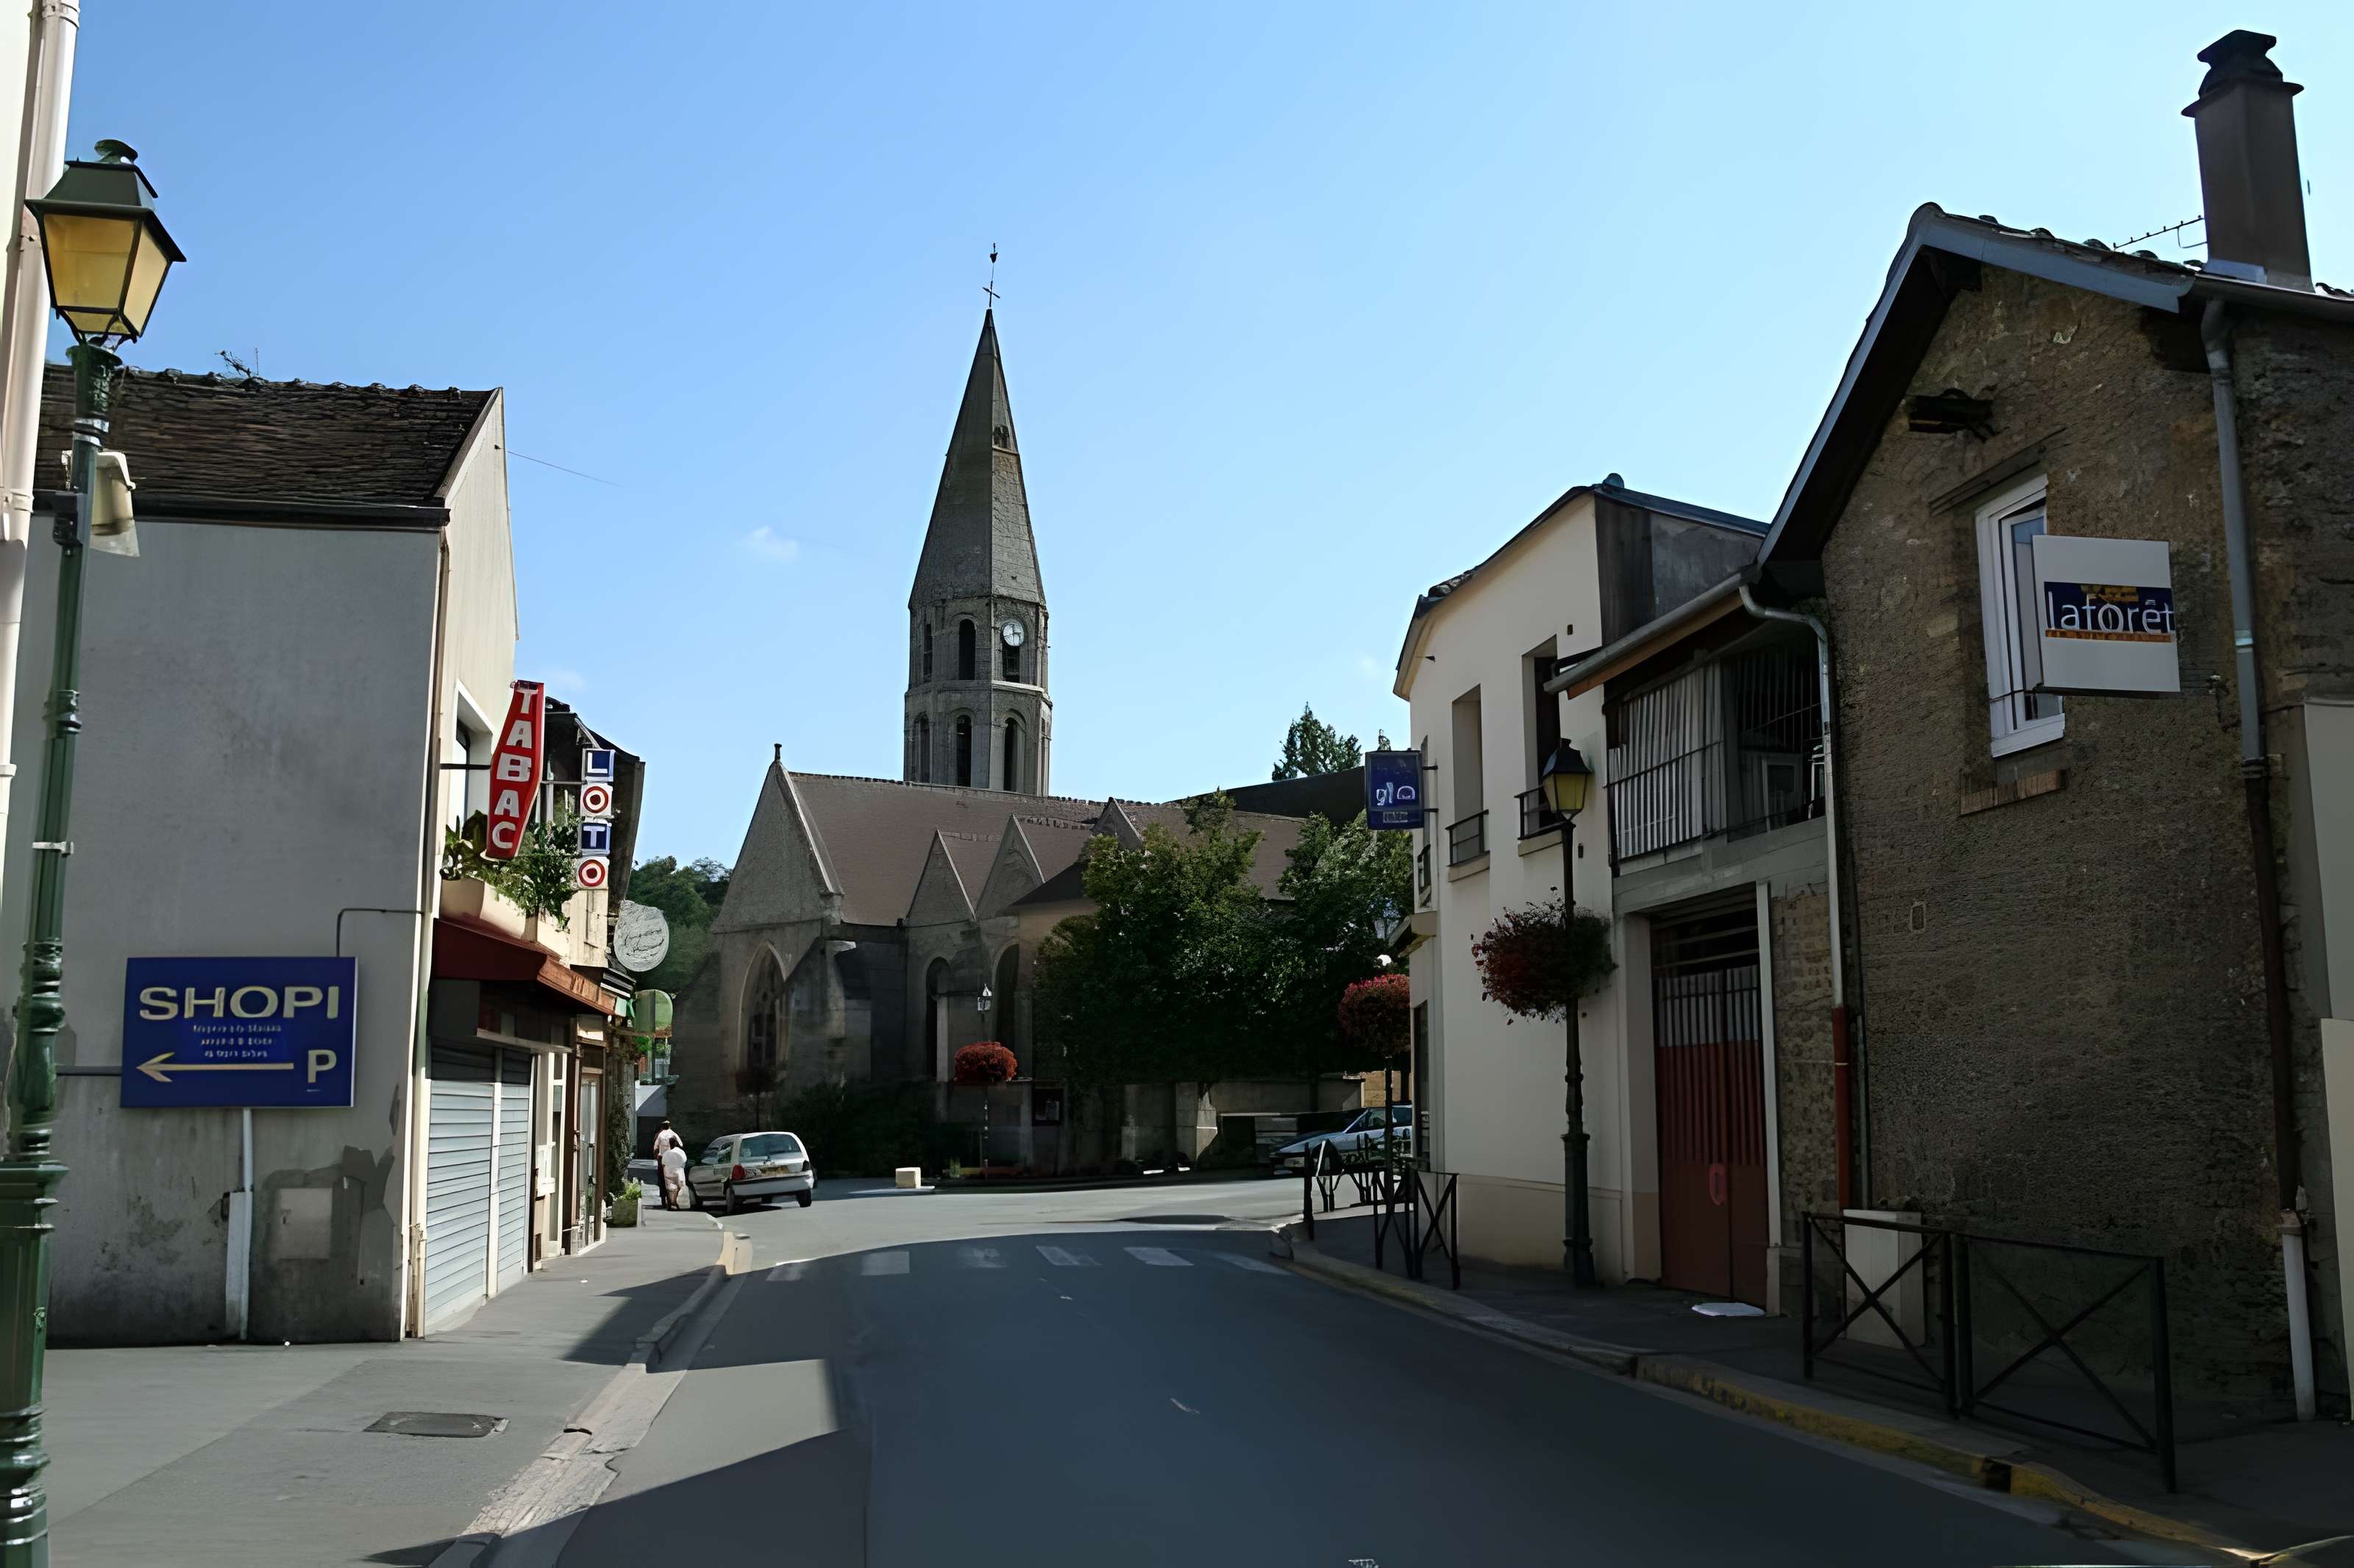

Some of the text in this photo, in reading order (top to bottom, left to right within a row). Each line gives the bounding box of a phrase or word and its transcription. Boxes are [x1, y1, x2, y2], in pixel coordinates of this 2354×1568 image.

[2048, 591, 2175, 635] laforêt
[491, 688, 538, 849] TABAC
[577, 752, 610, 887] LOTO
[139, 986, 340, 1021] SHOPI
[307, 1049, 338, 1083] P
